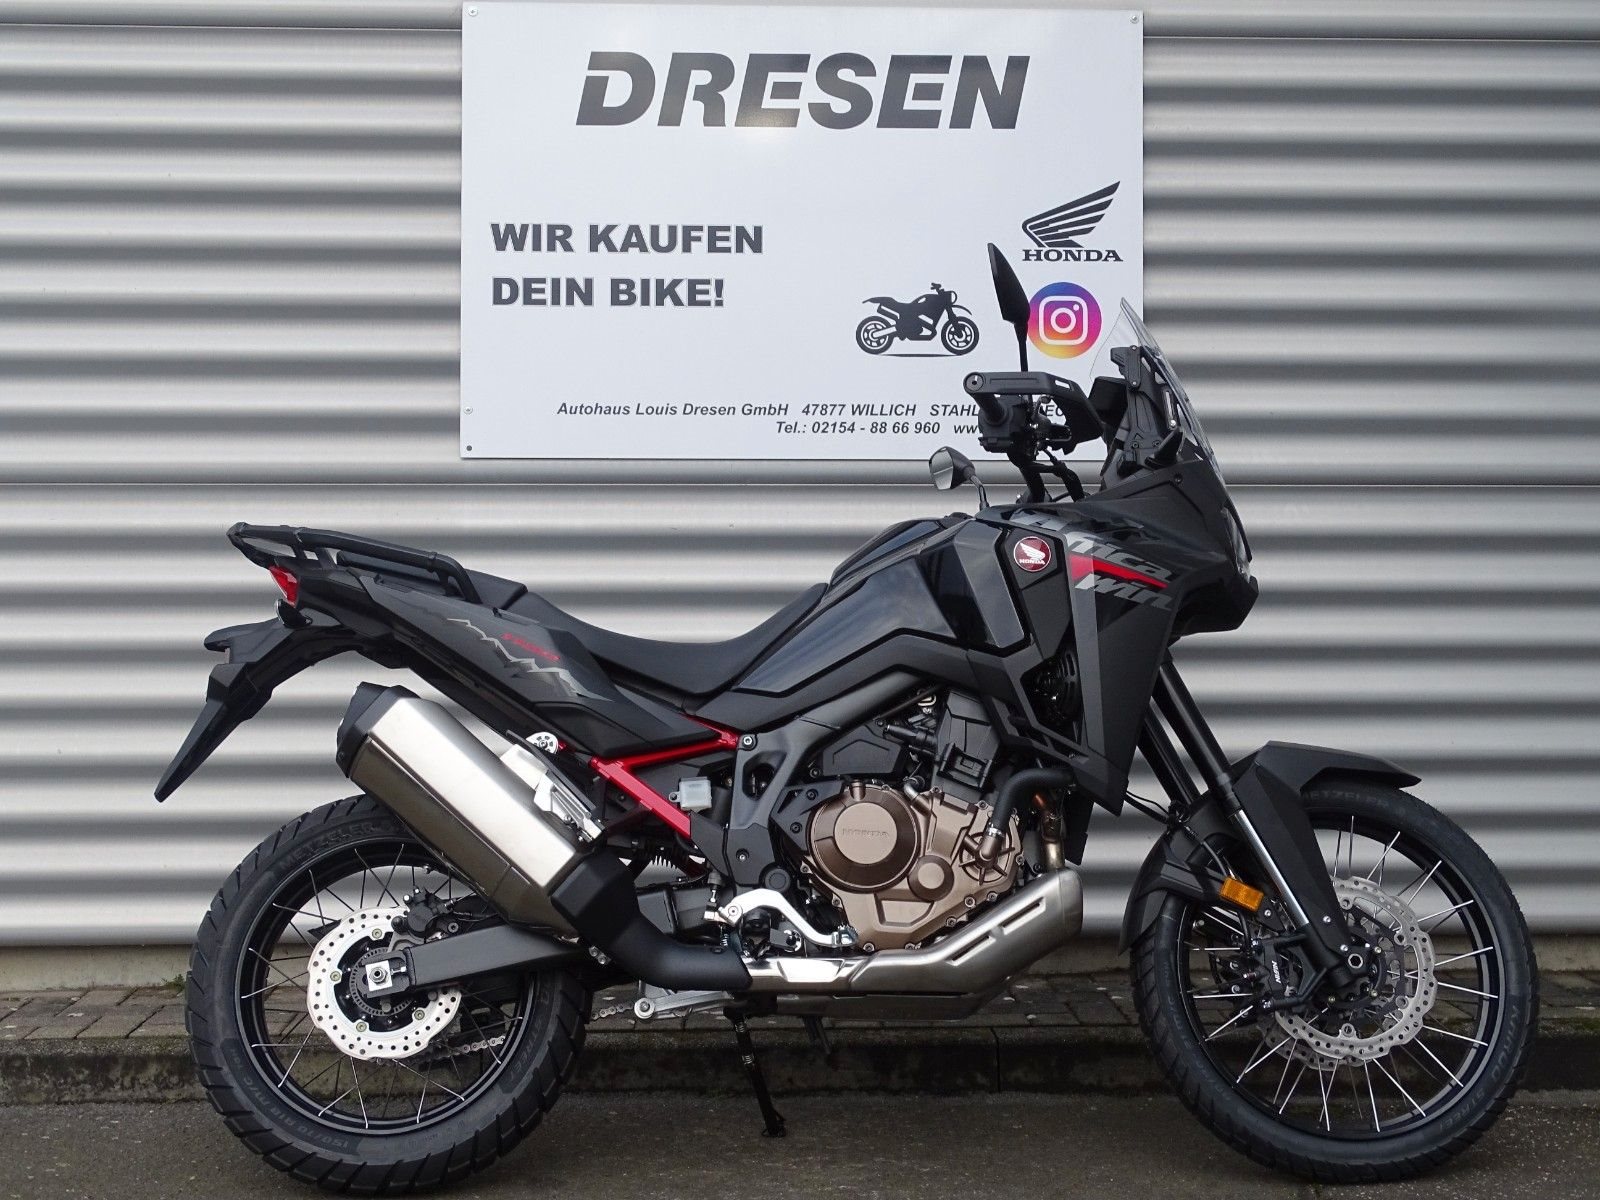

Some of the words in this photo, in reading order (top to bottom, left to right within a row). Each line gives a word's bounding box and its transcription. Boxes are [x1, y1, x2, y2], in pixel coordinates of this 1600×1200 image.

[576, 51, 1031, 130] DRESEN
[490, 223, 575, 253] WIR
[589, 224, 763, 254] KAUFEN
[1022, 248, 1124, 262] HONDA
[492, 277, 593, 306] DEIN
[610, 278, 724, 307] BIKE!
[557, 402, 631, 416] Autohaus
[635, 402, 678, 416] Louis
[682, 402, 736, 416] Dresen
[741, 403, 789, 416] GmbH
[801, 403, 847, 416] 47877
[851, 403, 917, 417] WILLICH
[929, 403, 979, 417] STAHL
[776, 420, 807, 434] Tel.:
[811, 421, 856, 434] 02154
[869, 421, 888, 434] 88
[892, 421, 910, 434] 66
[913, 421, 941, 434] 960
[1017, 558, 1046, 566] HONDA
[842, 828, 890, 841] HONDA
